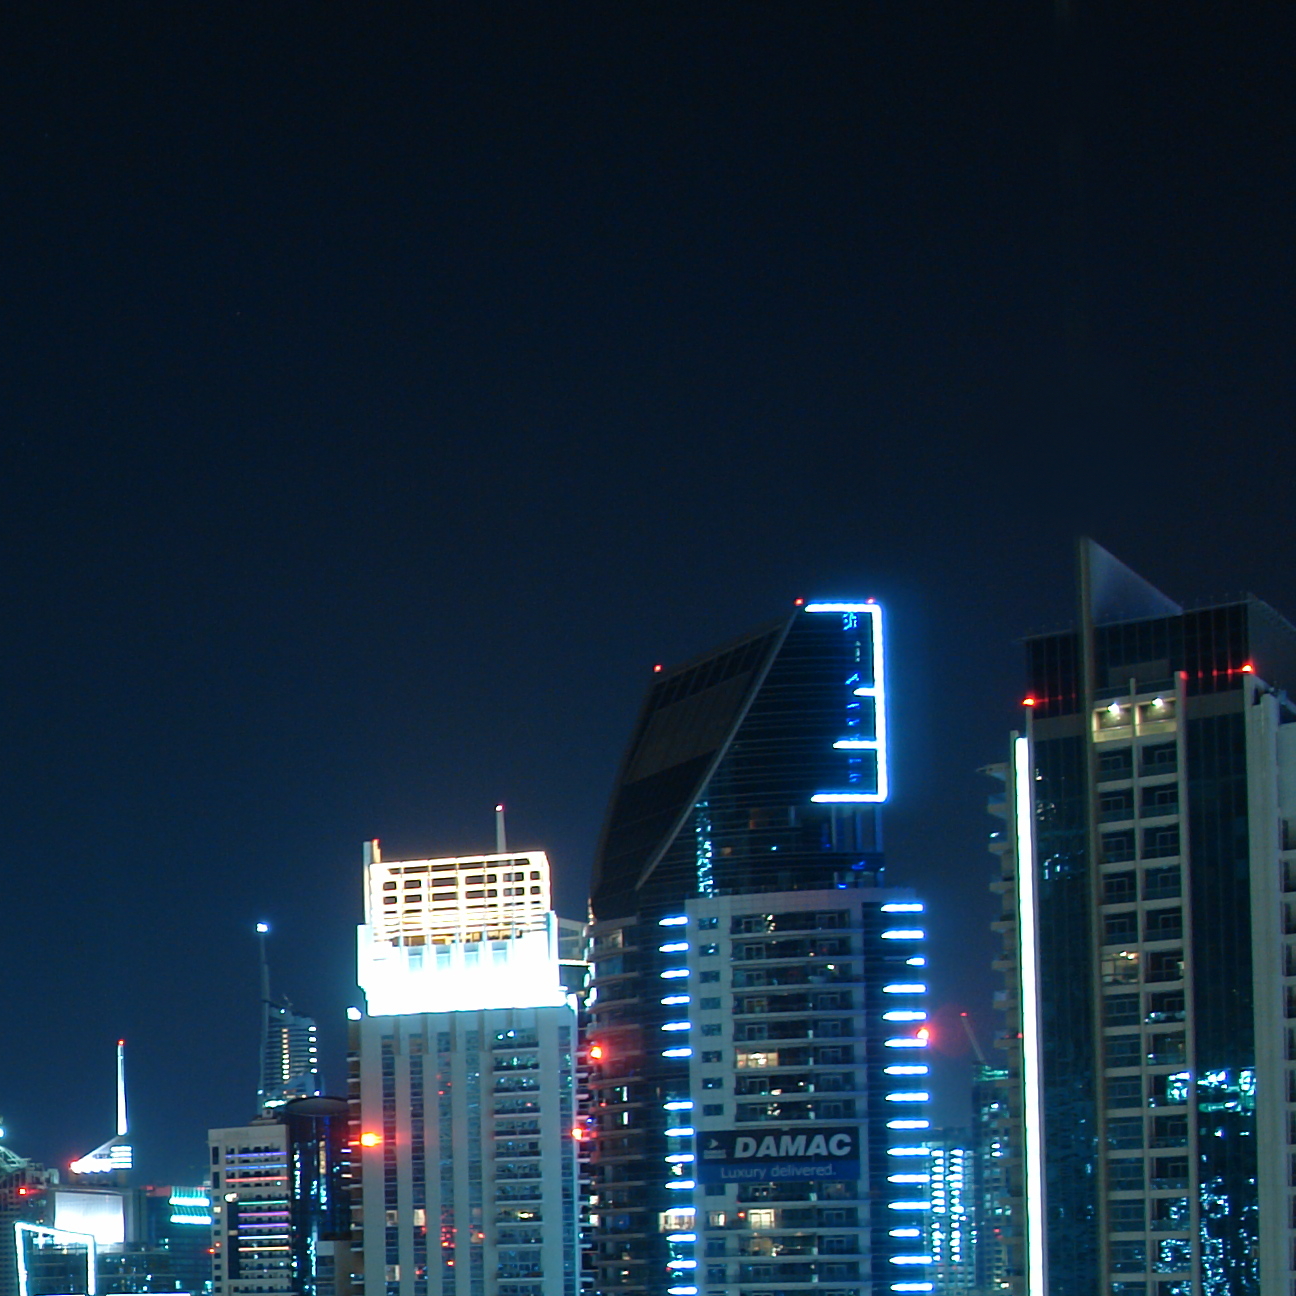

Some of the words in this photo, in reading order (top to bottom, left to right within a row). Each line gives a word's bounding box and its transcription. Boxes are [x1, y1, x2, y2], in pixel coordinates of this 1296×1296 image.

[734, 1133, 851, 1158] DAMAC
[721, 1167, 766, 1179] Luxury
[771, 1163, 836, 1177] delivered.
